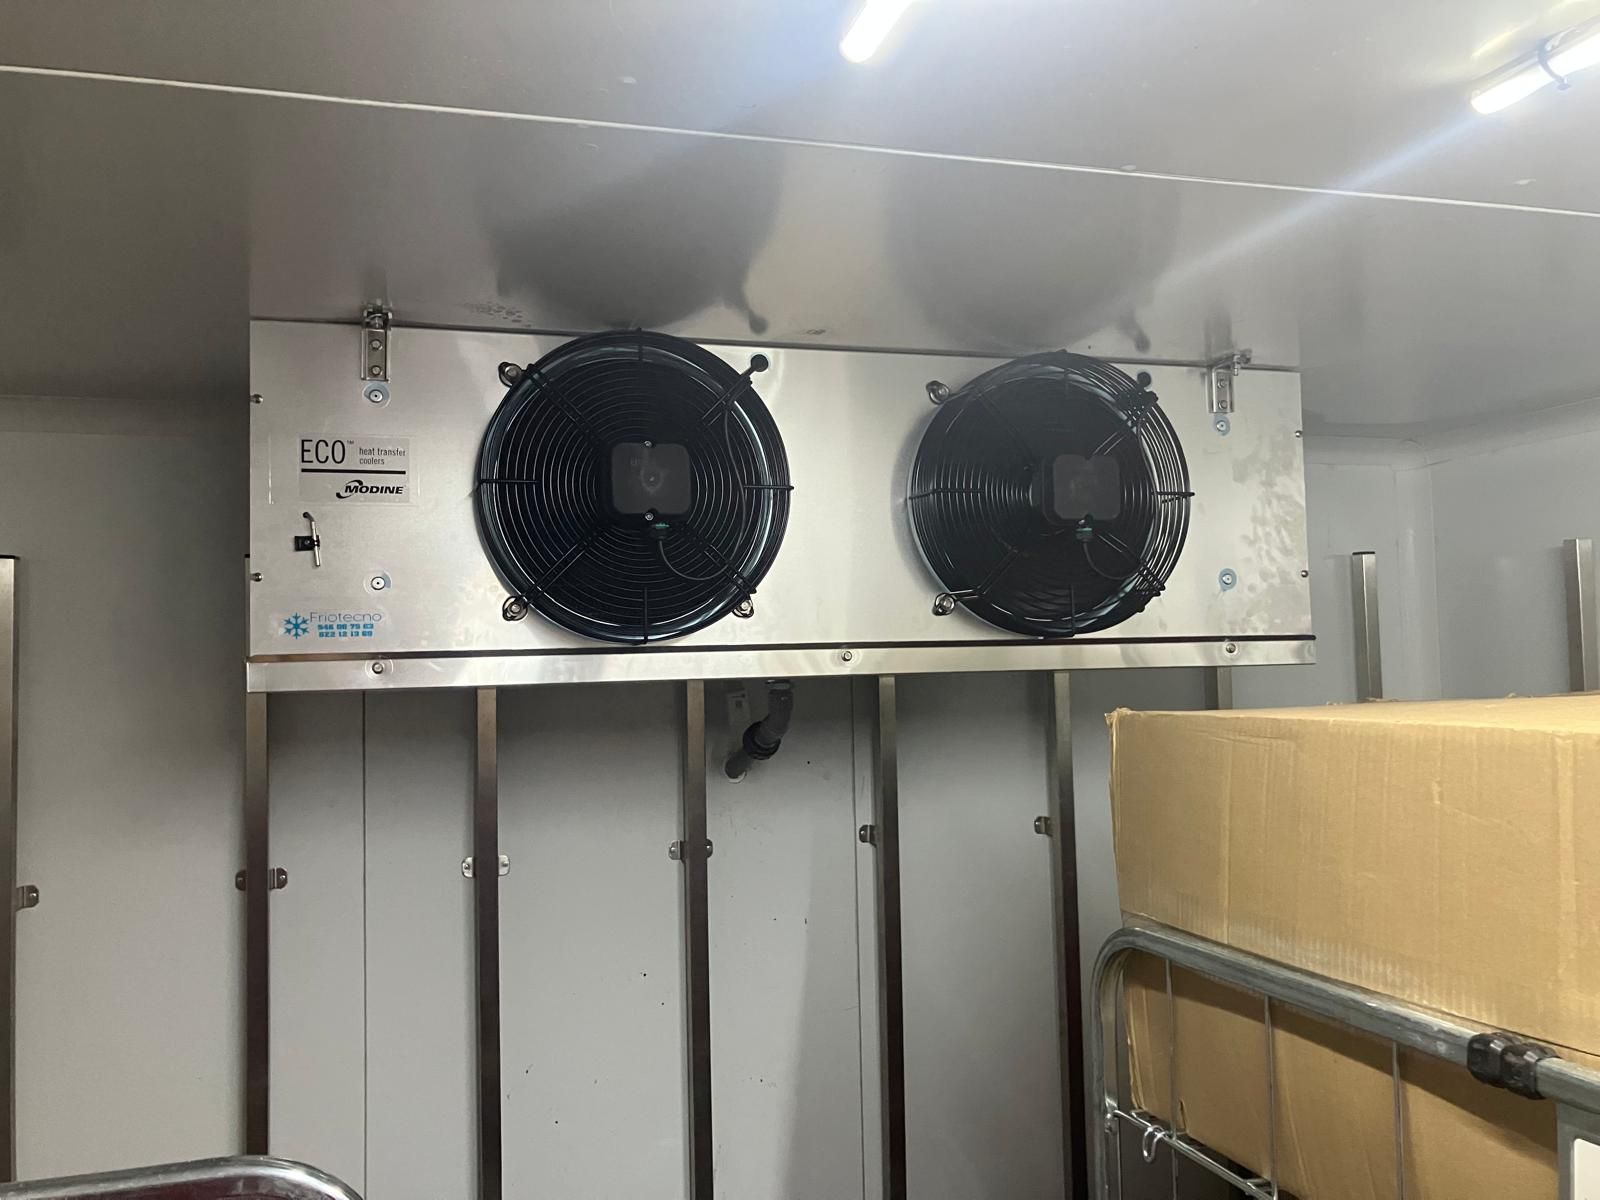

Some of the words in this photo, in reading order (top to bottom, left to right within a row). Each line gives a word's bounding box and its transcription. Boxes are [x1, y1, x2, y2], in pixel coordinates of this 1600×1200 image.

[359, 447, 375, 456] heat
[377, 448, 406, 456] transfer
[359, 457, 385, 465] coolers
[344, 485, 404, 495] MODINE
[310, 612, 382, 623] Friotecno
